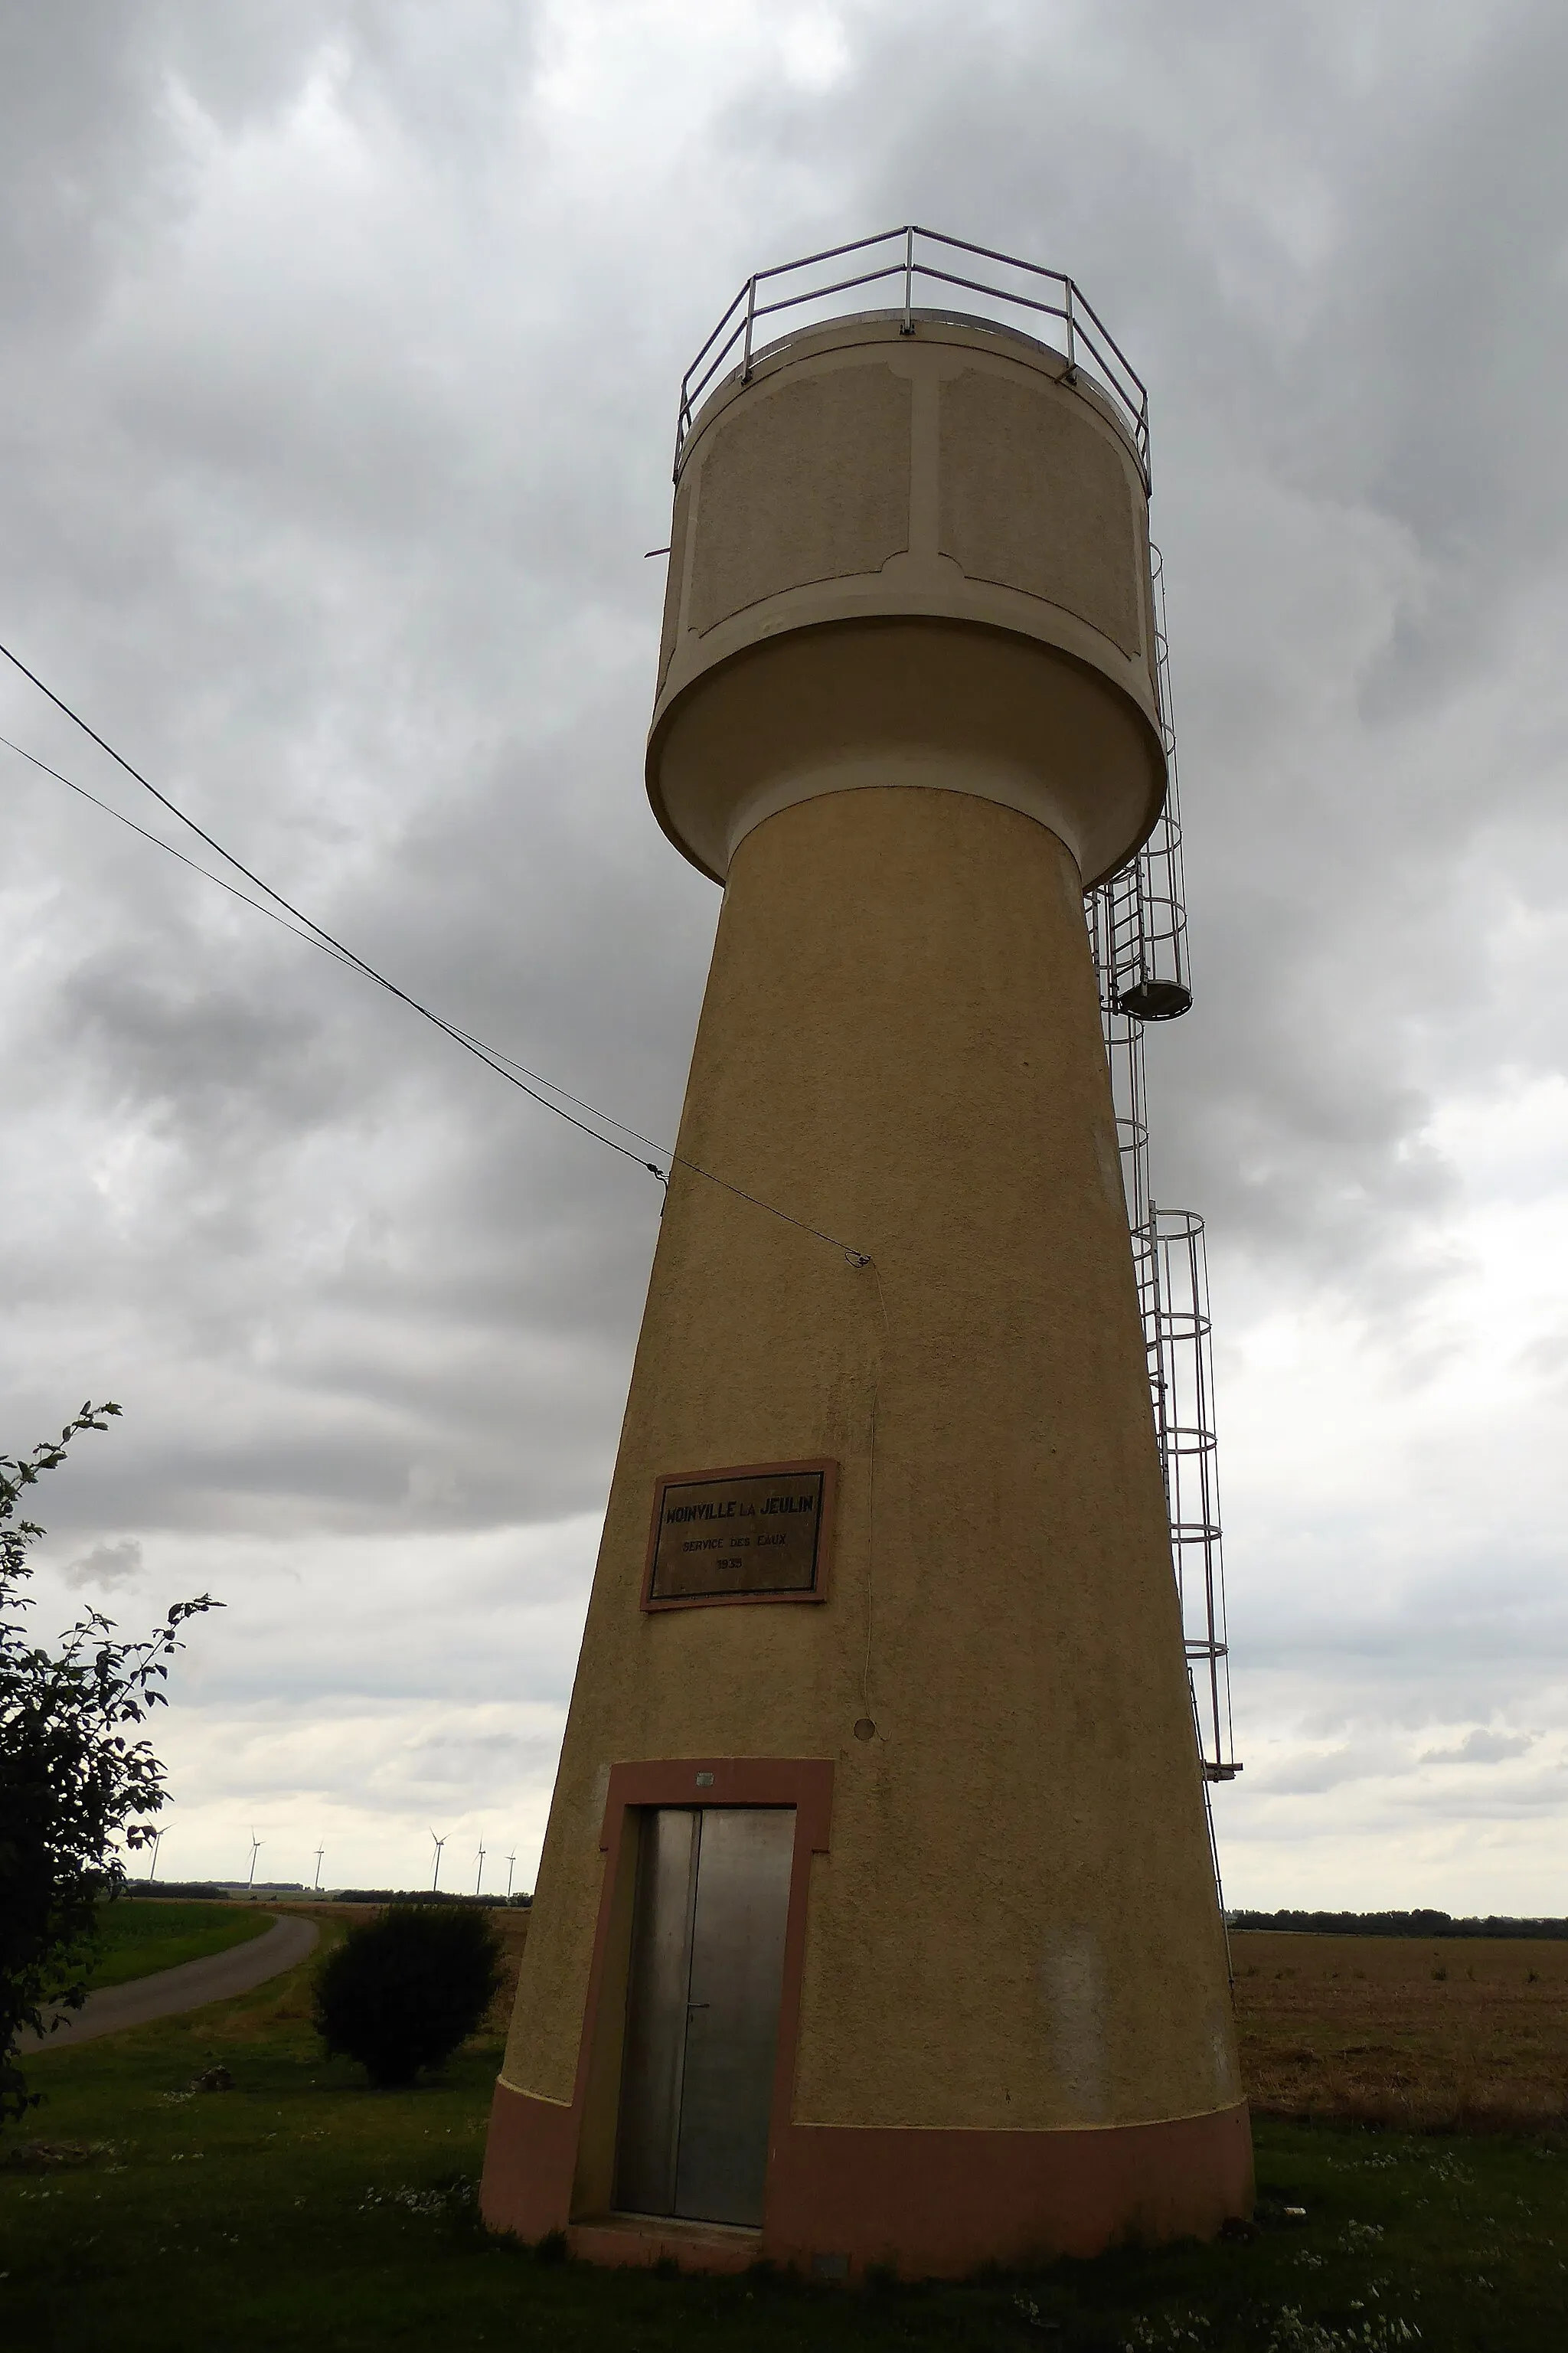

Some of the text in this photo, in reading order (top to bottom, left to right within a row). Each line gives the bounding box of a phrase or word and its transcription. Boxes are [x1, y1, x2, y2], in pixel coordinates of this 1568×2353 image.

[740, 1502, 756, 1516] LA
[760, 1495, 814, 1515] JEULIN
[682, 1534, 787, 1552] SERVICE DES EAUX
